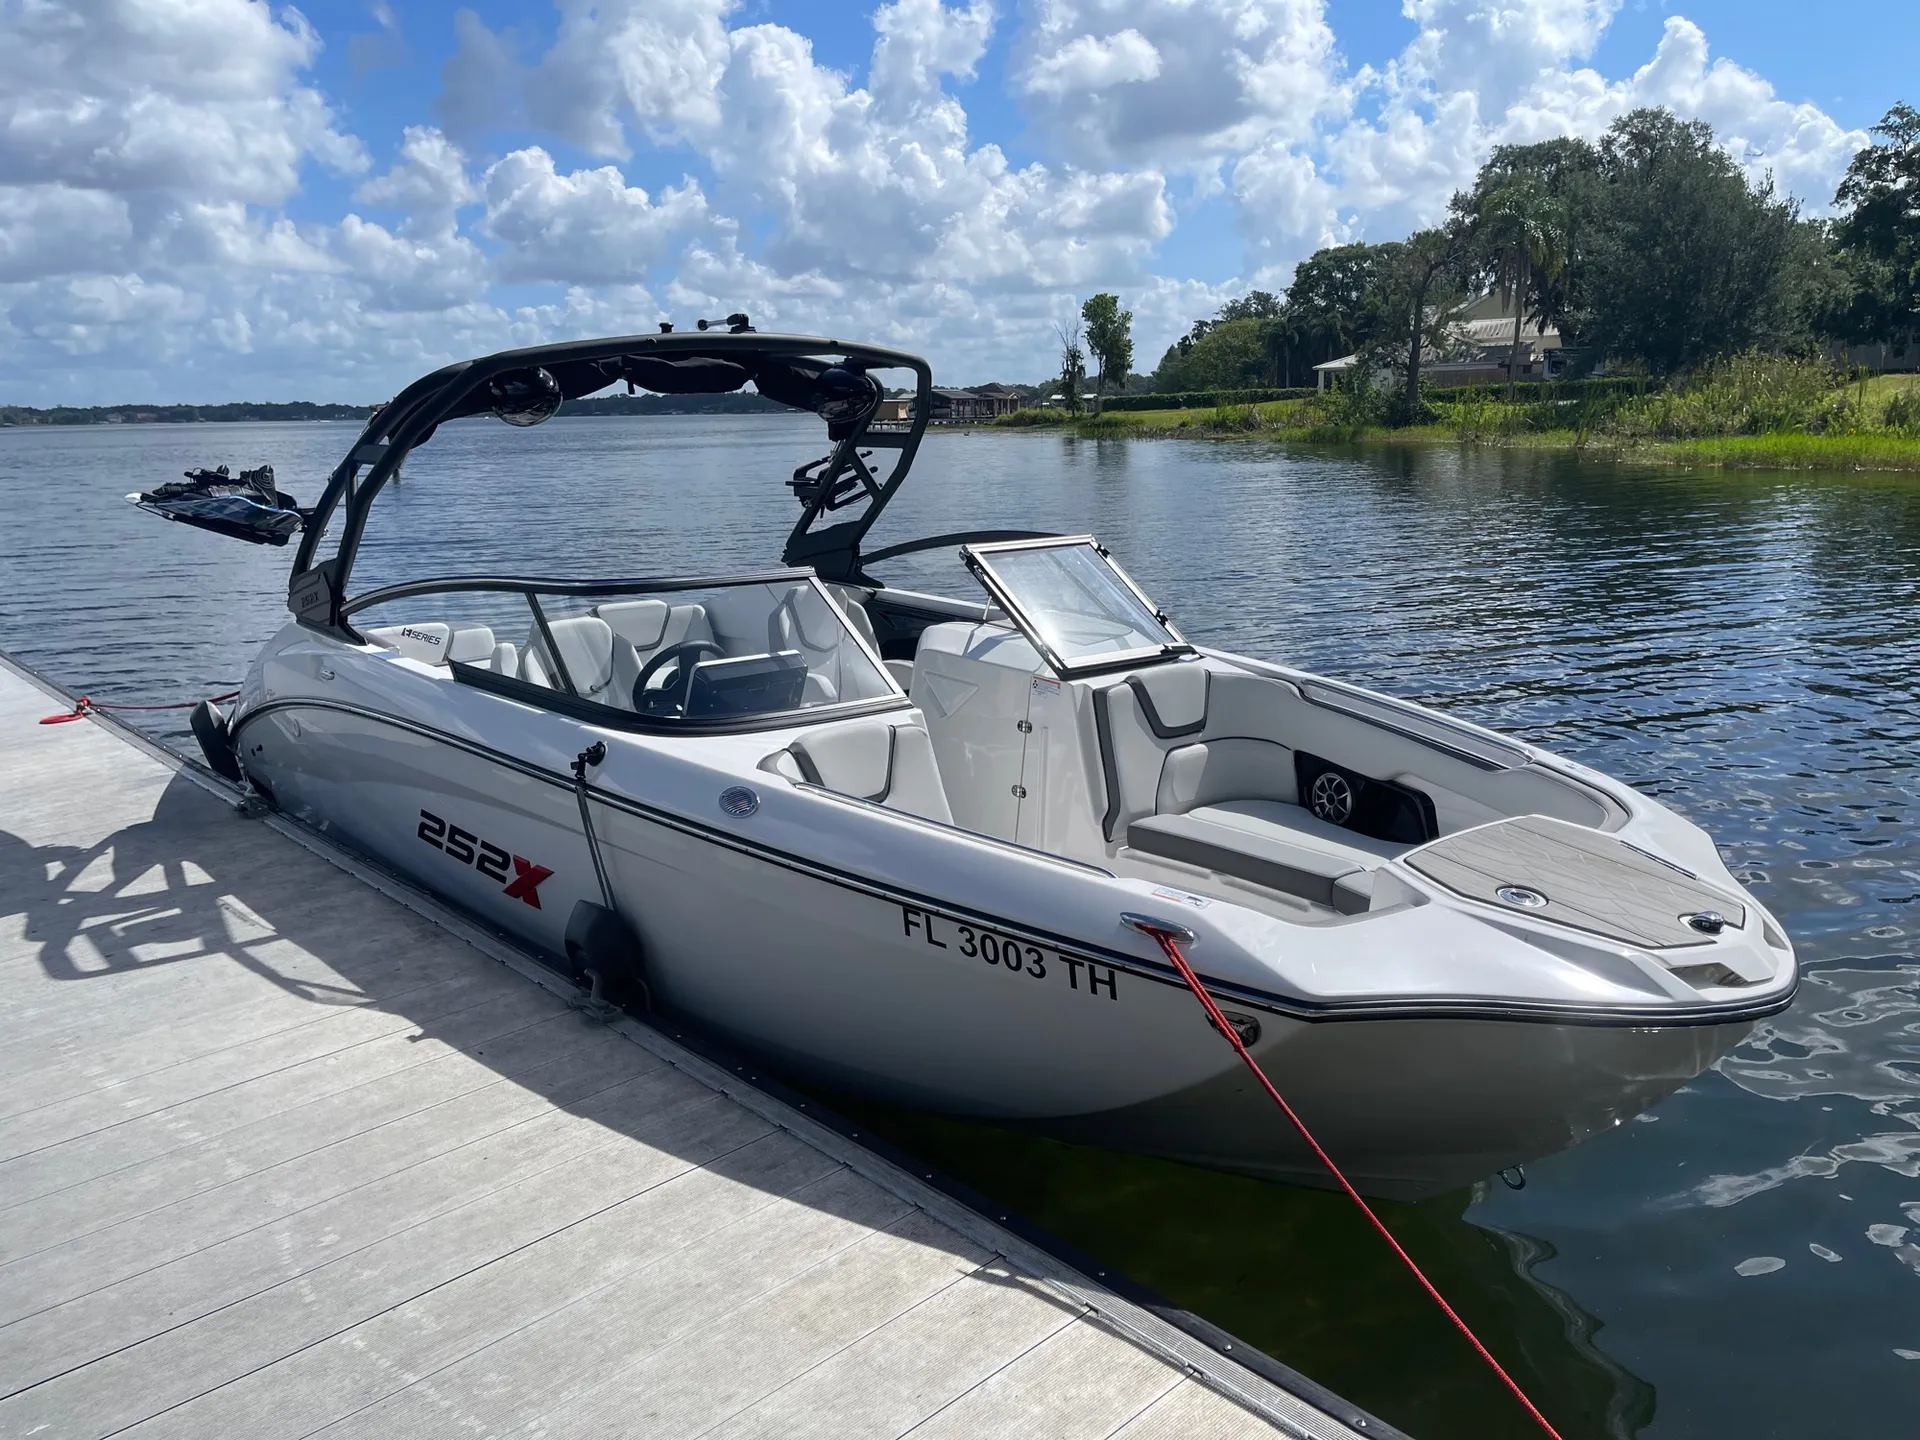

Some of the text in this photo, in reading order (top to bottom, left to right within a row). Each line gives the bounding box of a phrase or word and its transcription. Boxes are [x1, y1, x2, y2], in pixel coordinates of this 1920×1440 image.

[411, 630, 441, 645] SERIES
[417, 808, 555, 910] 252X
[902, 906, 1118, 1001] FL 3003 TH
